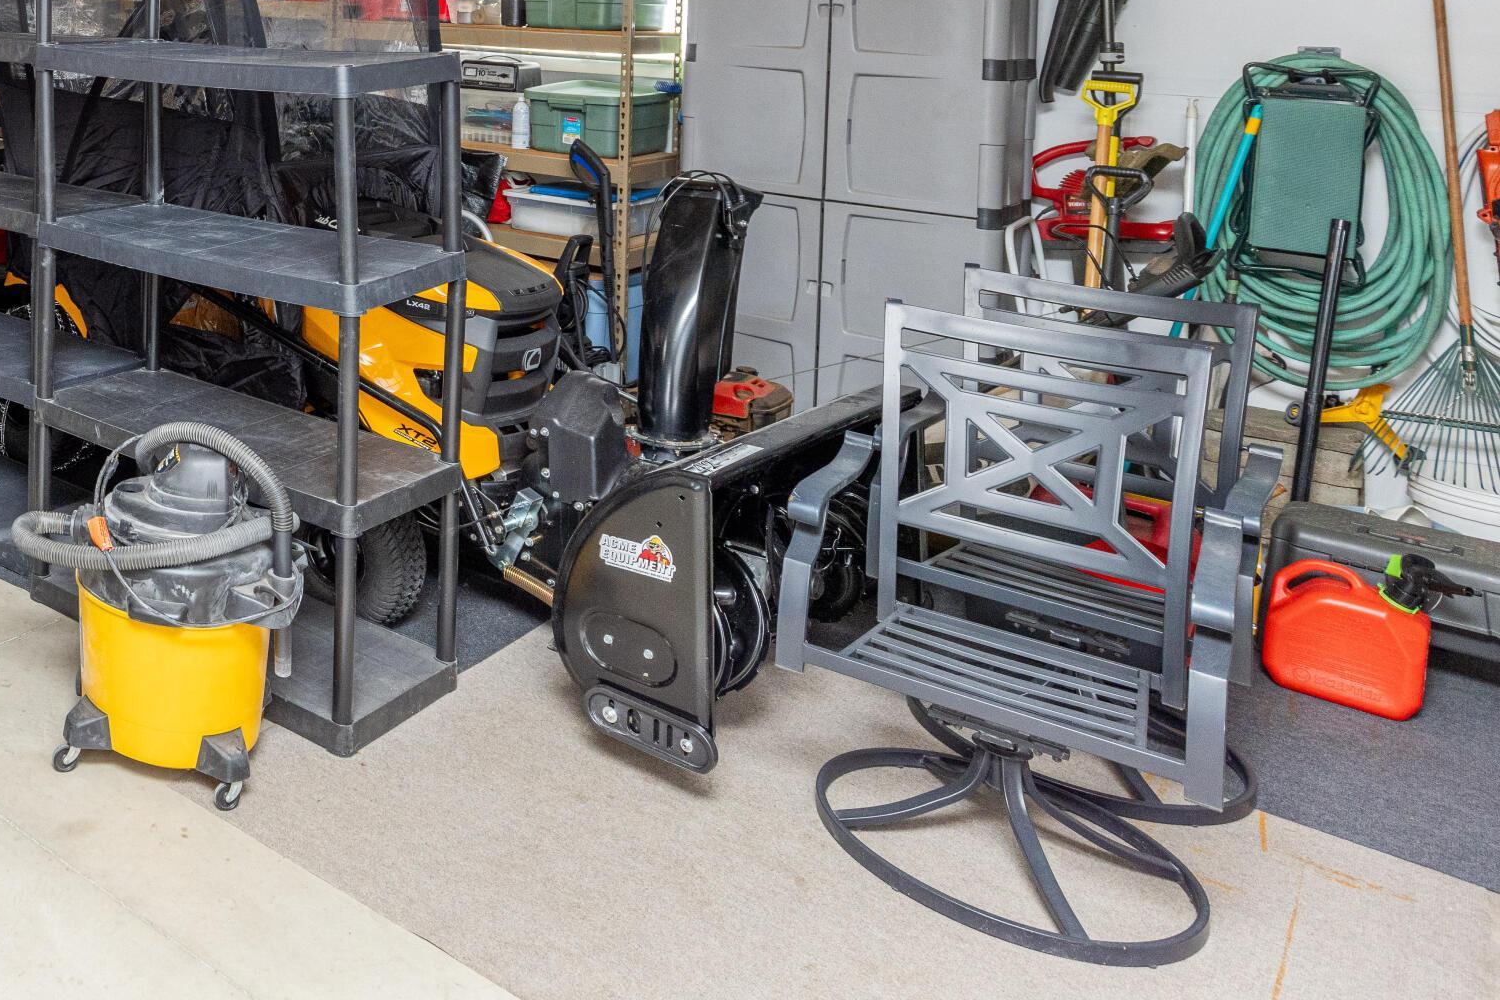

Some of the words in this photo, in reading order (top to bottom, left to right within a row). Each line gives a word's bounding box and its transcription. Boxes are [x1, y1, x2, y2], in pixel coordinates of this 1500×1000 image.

[395, 423, 438, 448] XT2
[601, 534, 638, 554] ACME
[601, 546, 677, 577] EQUIPMENT
